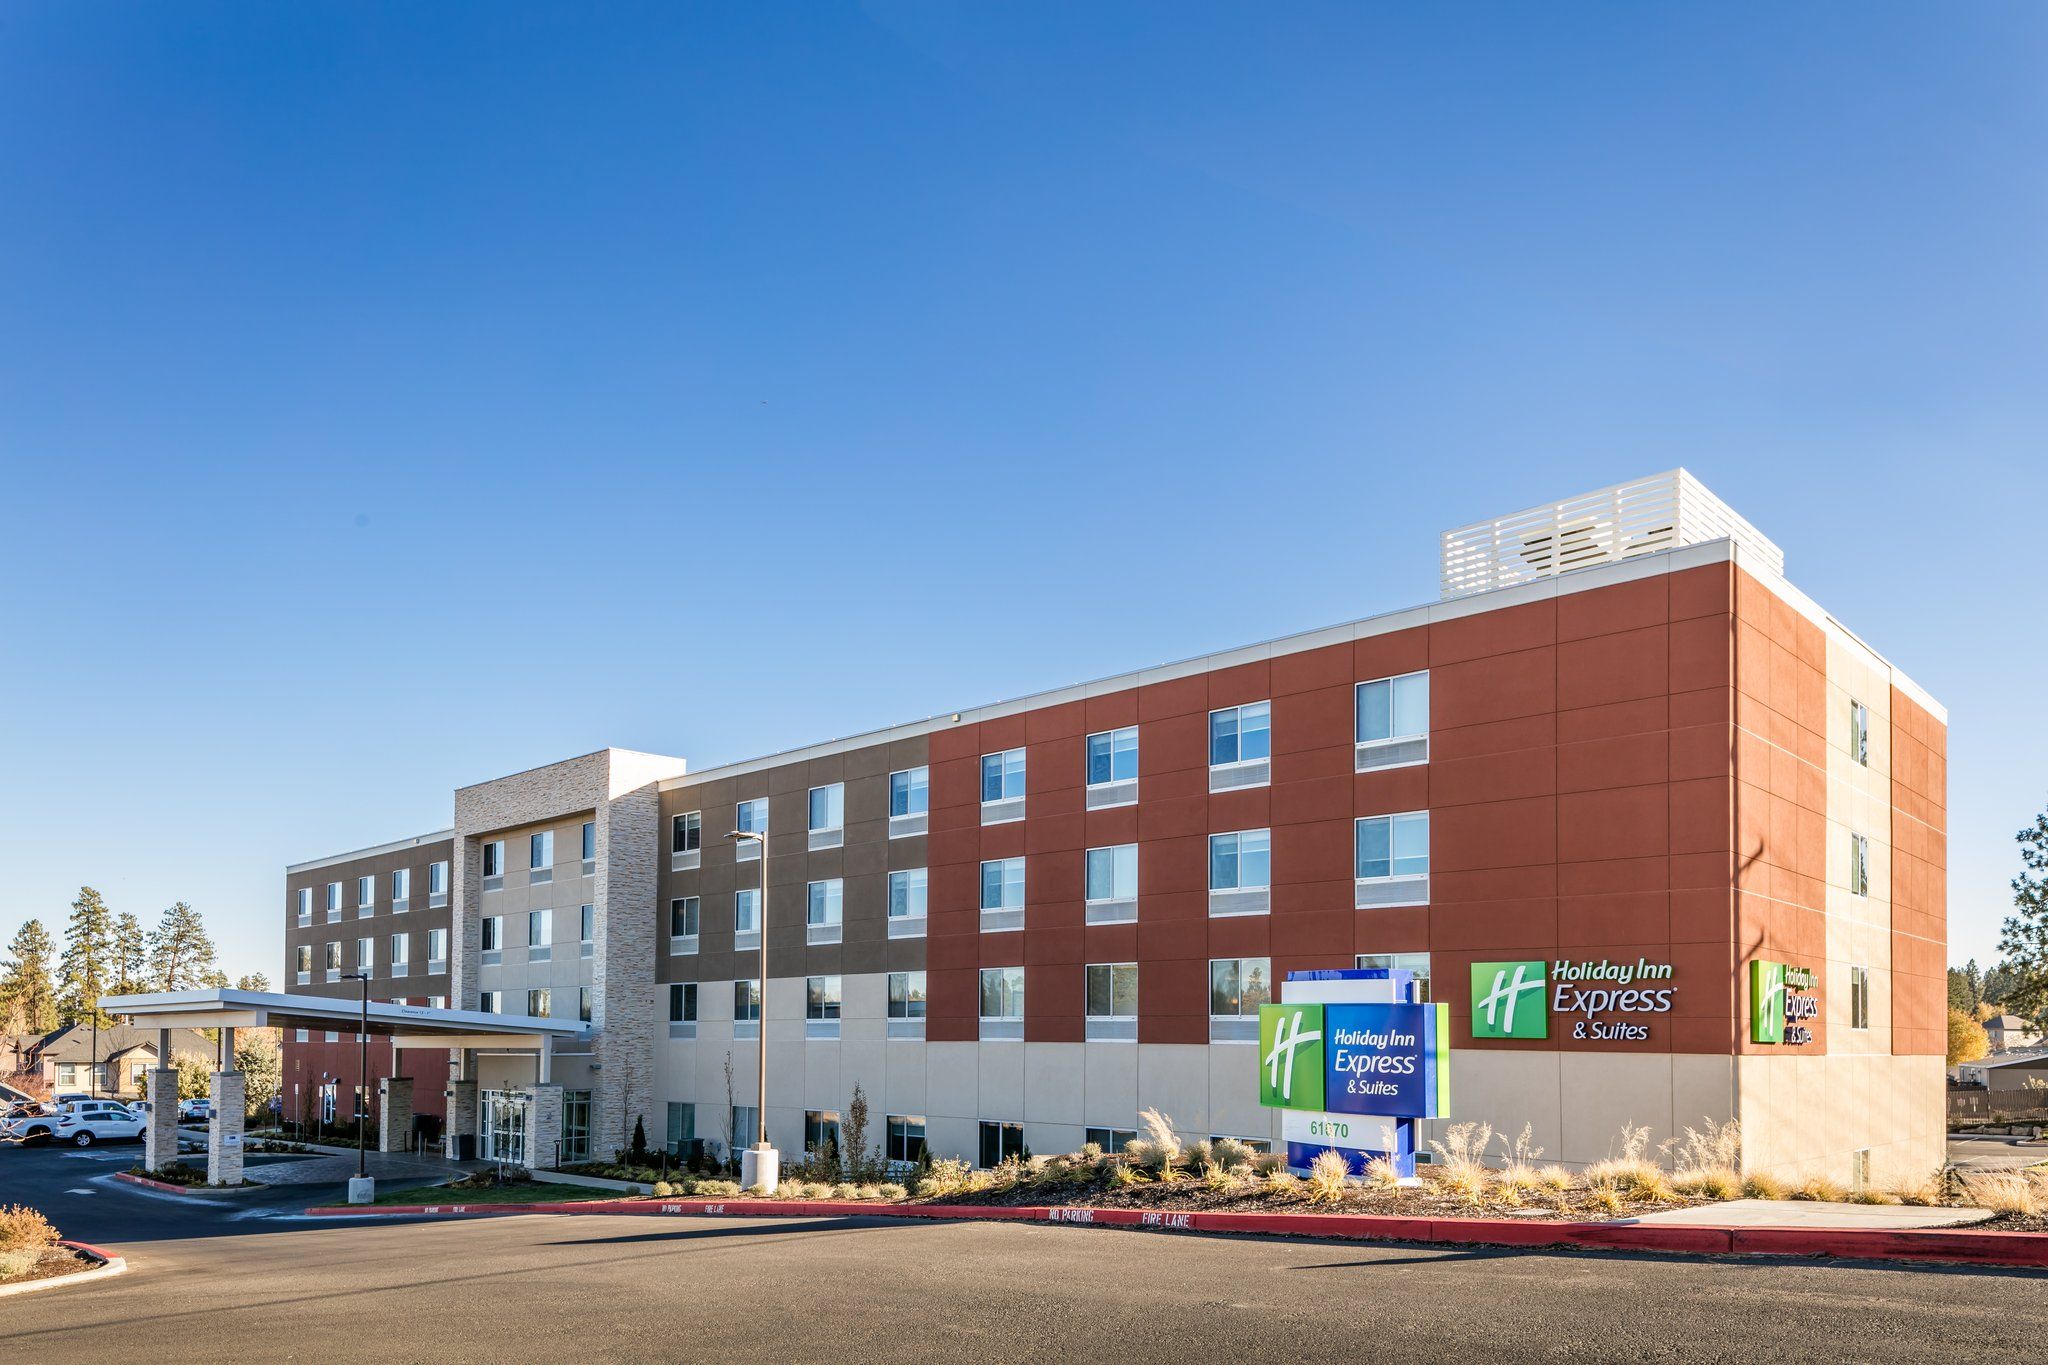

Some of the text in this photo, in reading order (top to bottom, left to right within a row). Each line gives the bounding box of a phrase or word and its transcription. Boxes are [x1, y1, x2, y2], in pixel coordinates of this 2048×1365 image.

[1551, 958, 1673, 985] Holiday Inn
[1785, 964, 1818, 991] Holiday Inn
[1553, 983, 1672, 1020] Express
[1785, 988, 1818, 1022] Express
[1334, 1028, 1415, 1050] Holiday Inn
[1573, 1021, 1648, 1040] & Suites
[1797, 1026, 1812, 1044] Suites
[1335, 1049, 1415, 1079] Express
[1347, 1079, 1398, 1096] & Suites
[1049, 1209, 1094, 1222] NO PARKING
[1142, 1212, 1190, 1227] FIRE LANE
